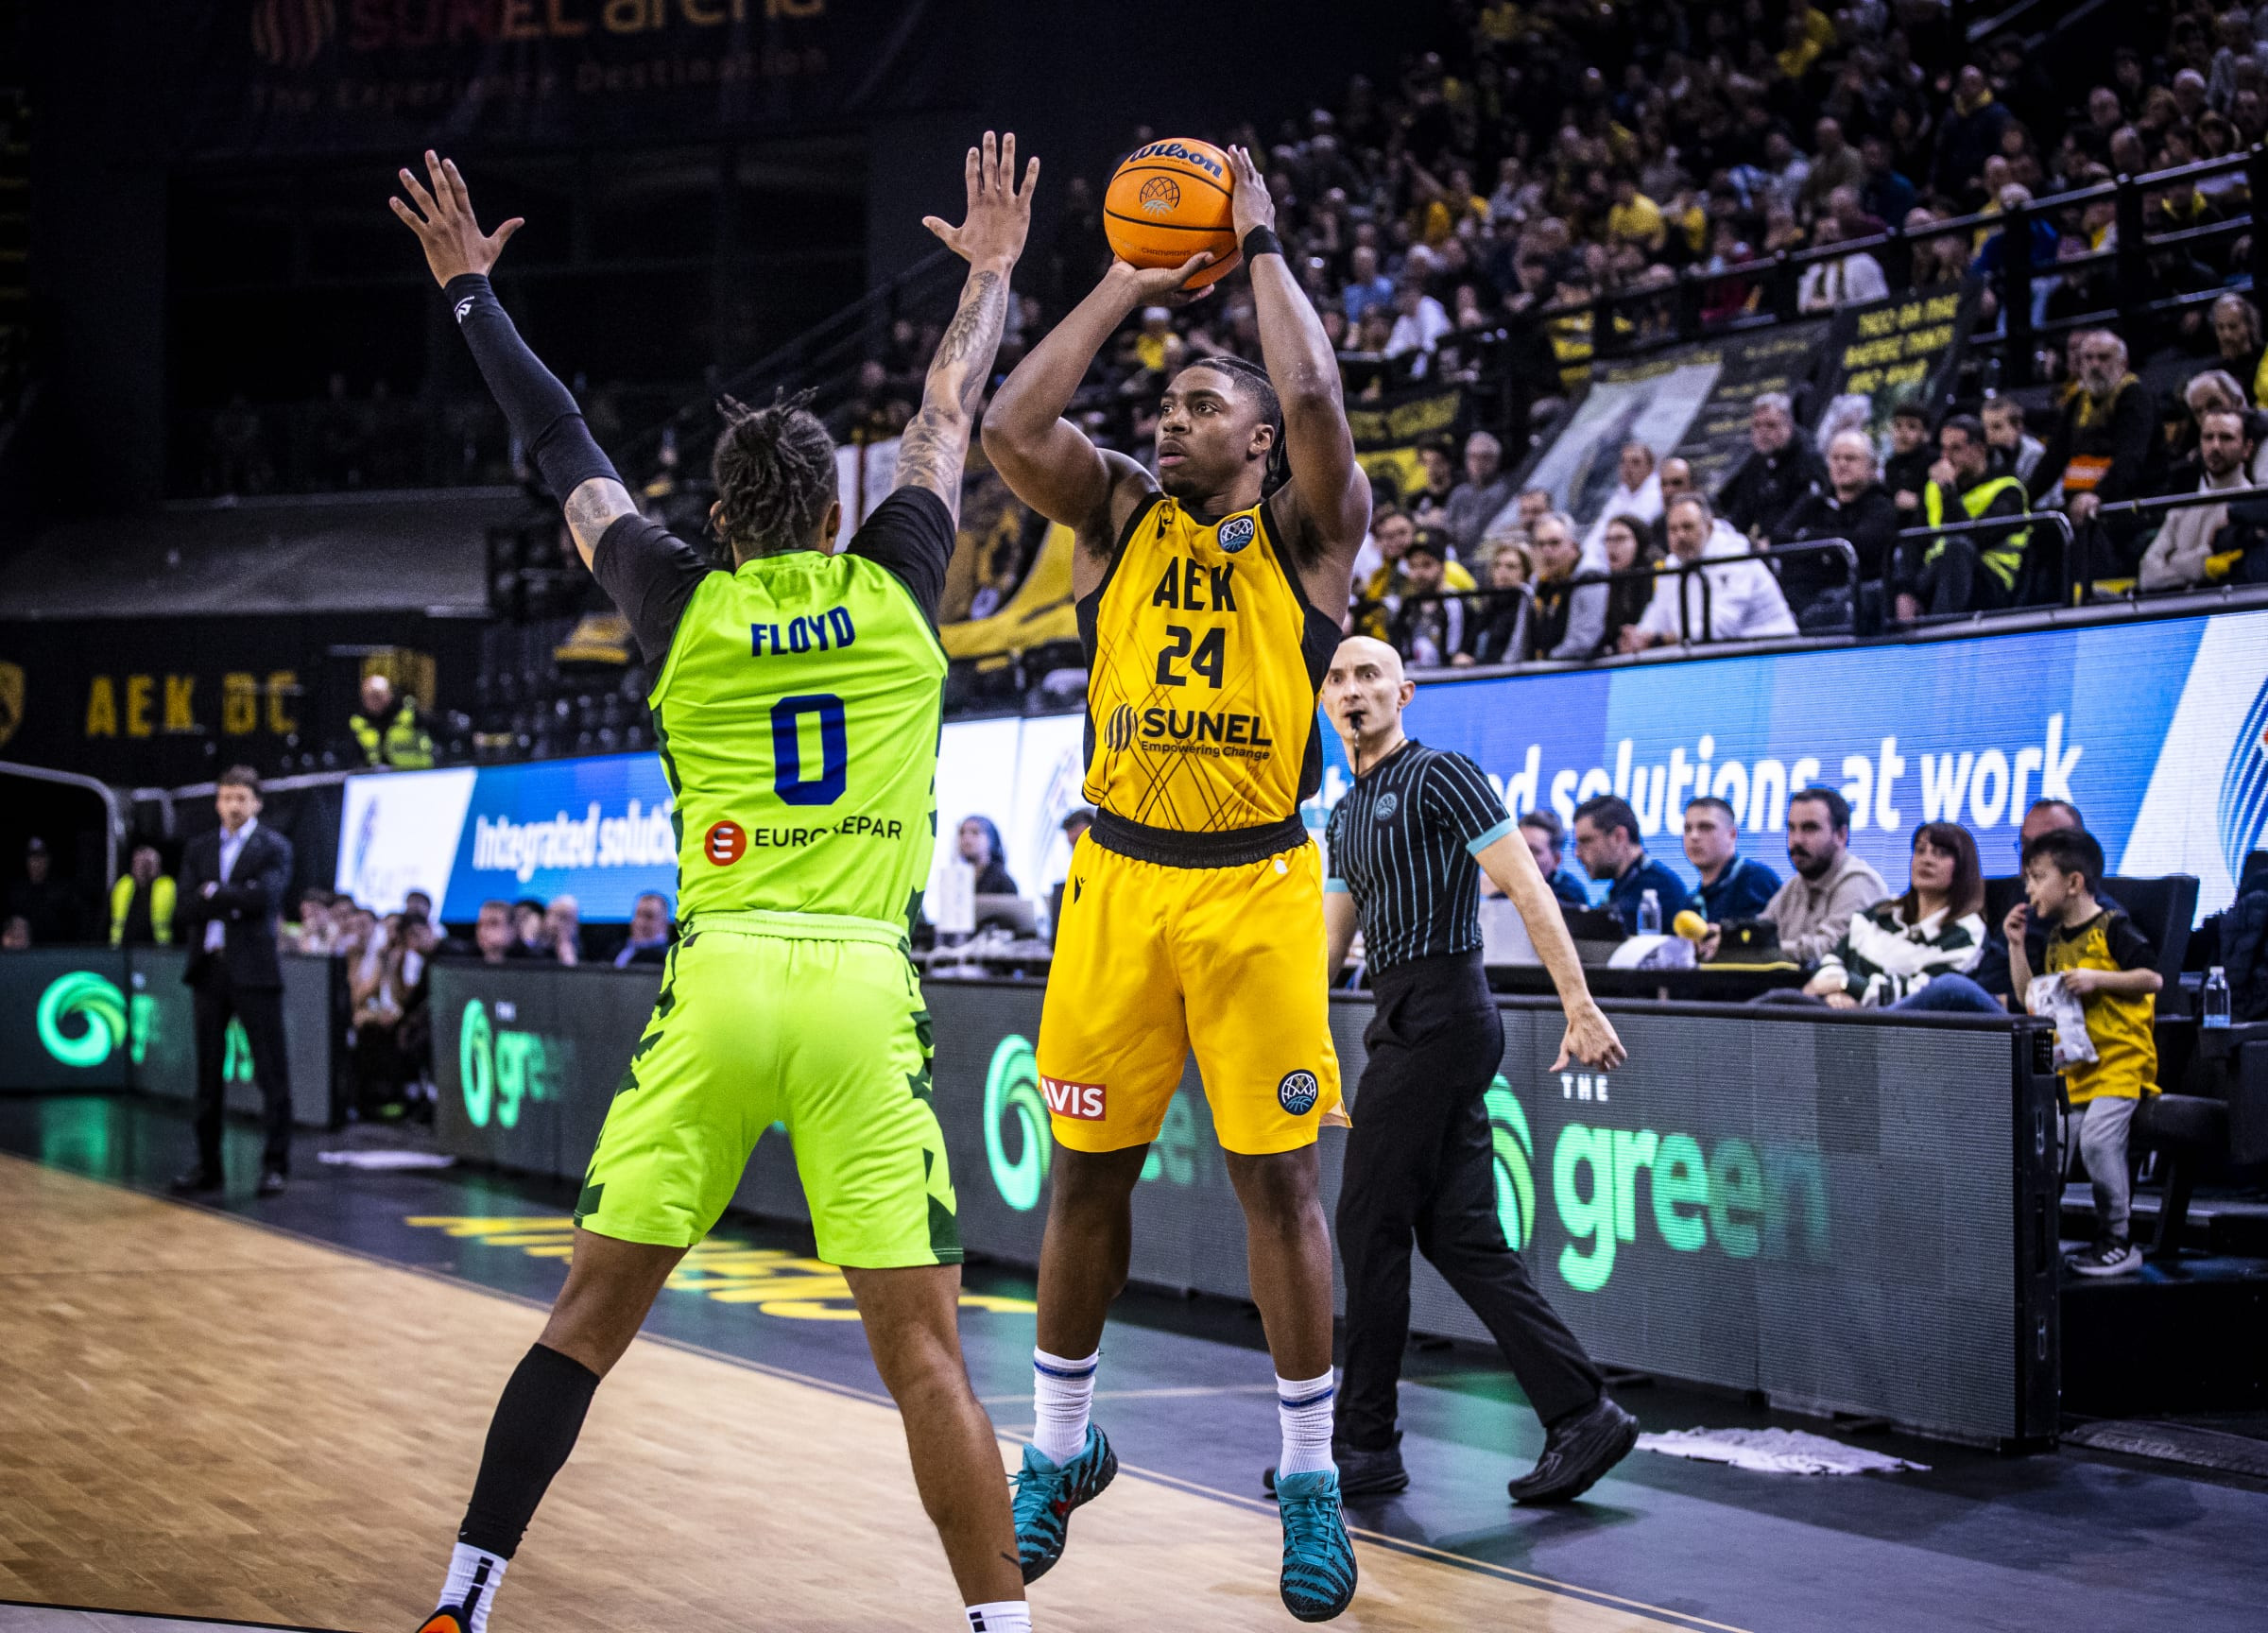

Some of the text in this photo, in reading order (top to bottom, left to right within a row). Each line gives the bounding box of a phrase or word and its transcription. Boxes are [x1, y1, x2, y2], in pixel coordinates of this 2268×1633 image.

[1128, 143, 1223, 180] Wilson
[1152, 556, 1237, 612] AEK
[750, 606, 856, 657] FLOYD
[1155, 625, 1226, 689] 24
[86, 674, 195, 737] AEK
[1142, 707, 1272, 747] SUNEL
[770, 693, 848, 806] 0
[1141, 741, 1270, 760] Empowering Change
[1842, 736, 1905, 832] at
[1921, 713, 2083, 829] work
[473, 801, 601, 883] Integrated
[597, 798, 679, 868] soluti
[755, 816, 902, 847] EUROEPAR
[1561, 1073, 1608, 1102] THE
[1553, 1122, 1830, 1293] green
